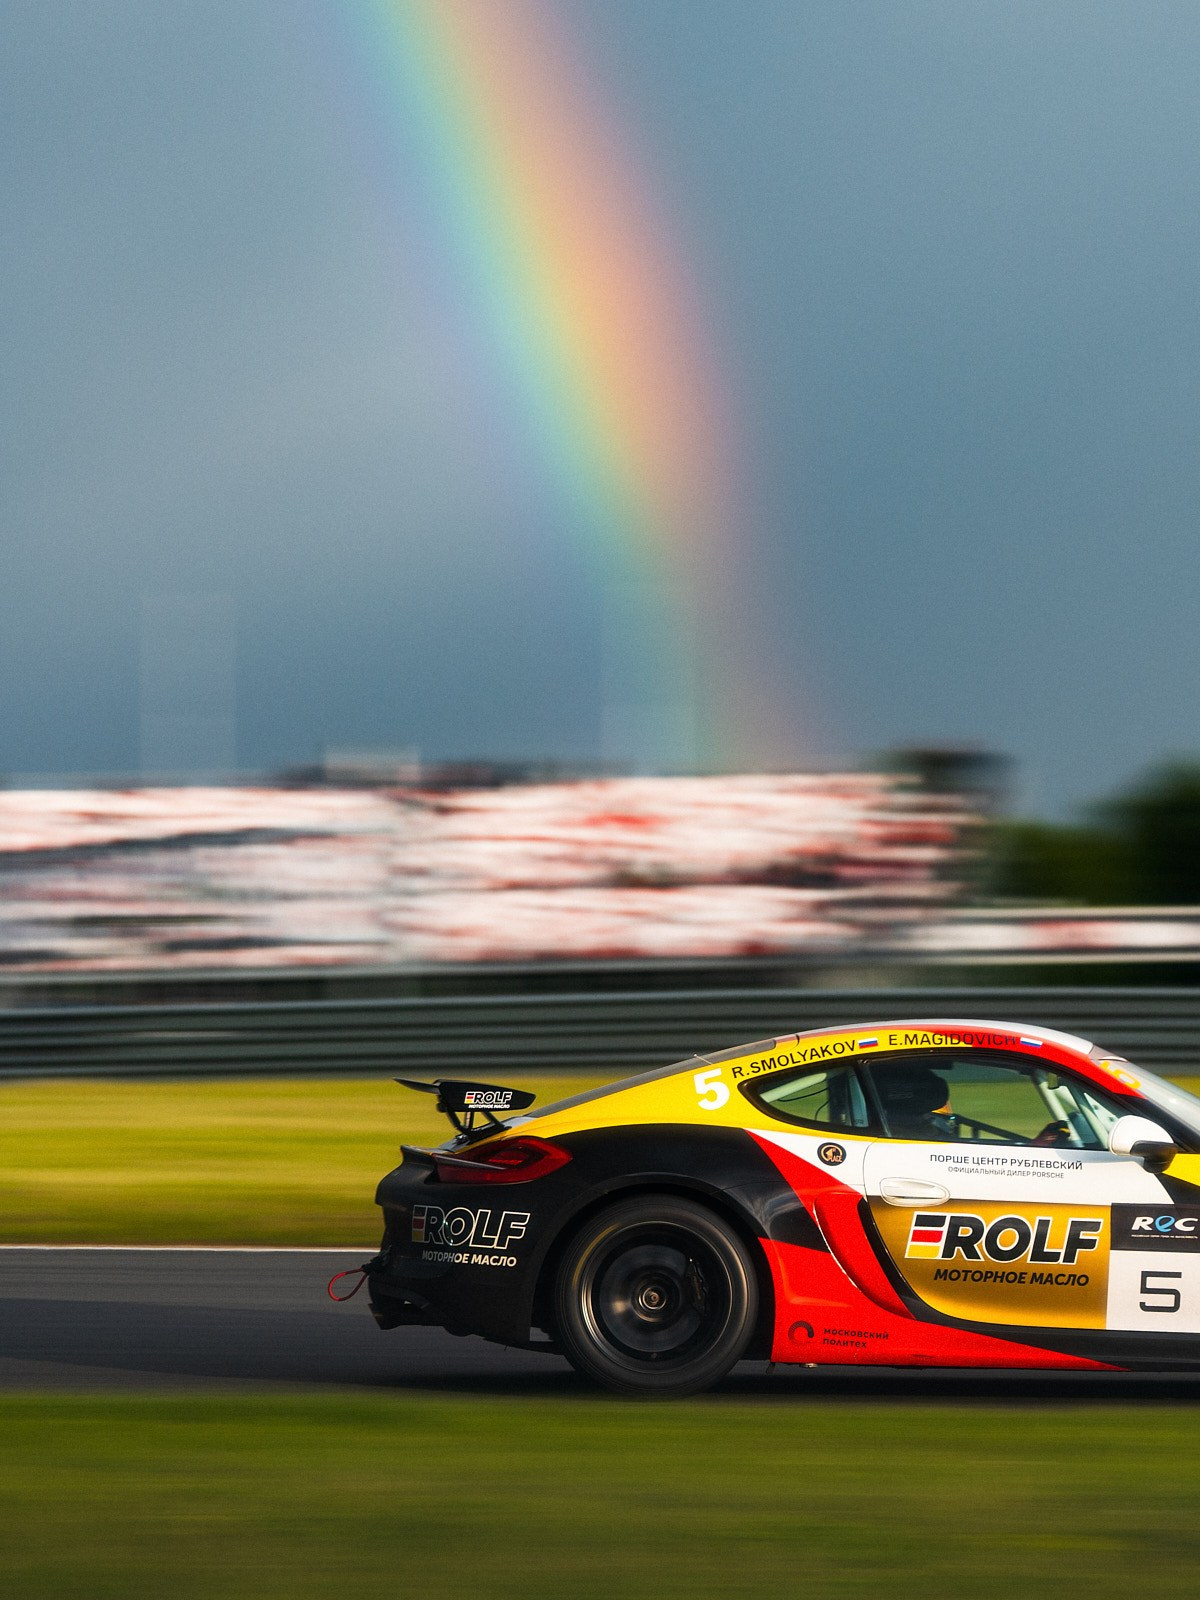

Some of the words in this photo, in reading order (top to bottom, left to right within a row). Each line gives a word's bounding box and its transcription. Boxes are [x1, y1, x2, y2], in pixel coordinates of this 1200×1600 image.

[888, 1032, 1016, 1046] E.MAGIDOVICH
[732, 1040, 856, 1078] R.SMOLYAKOV
[473, 1091, 512, 1104] ROLF
[693, 1068, 730, 1111] 5
[930, 1154, 969, 1164] ПОРШЕ
[972, 1156, 1008, 1166] ЦЕНТР
[1010, 1158, 1083, 1170] РУБЛЕВСКИЙ
[948, 1166, 1006, 1176] ОФИЦИАЛЬНЫЙ
[1007, 1169, 1031, 1177] ДИЛЕР
[1032, 1171, 1064, 1179] PORSCHE
[424, 1205, 531, 1249] ROLF
[941, 1210, 1104, 1265] ROLF
[422, 1250, 470, 1264] МОТОРНОЕ
[470, 1254, 517, 1267] МАСЛО
[934, 1268, 1028, 1285] МОТОРНОЕ
[1029, 1272, 1090, 1287] МАСЛО
[1139, 1270, 1182, 1313] 5
